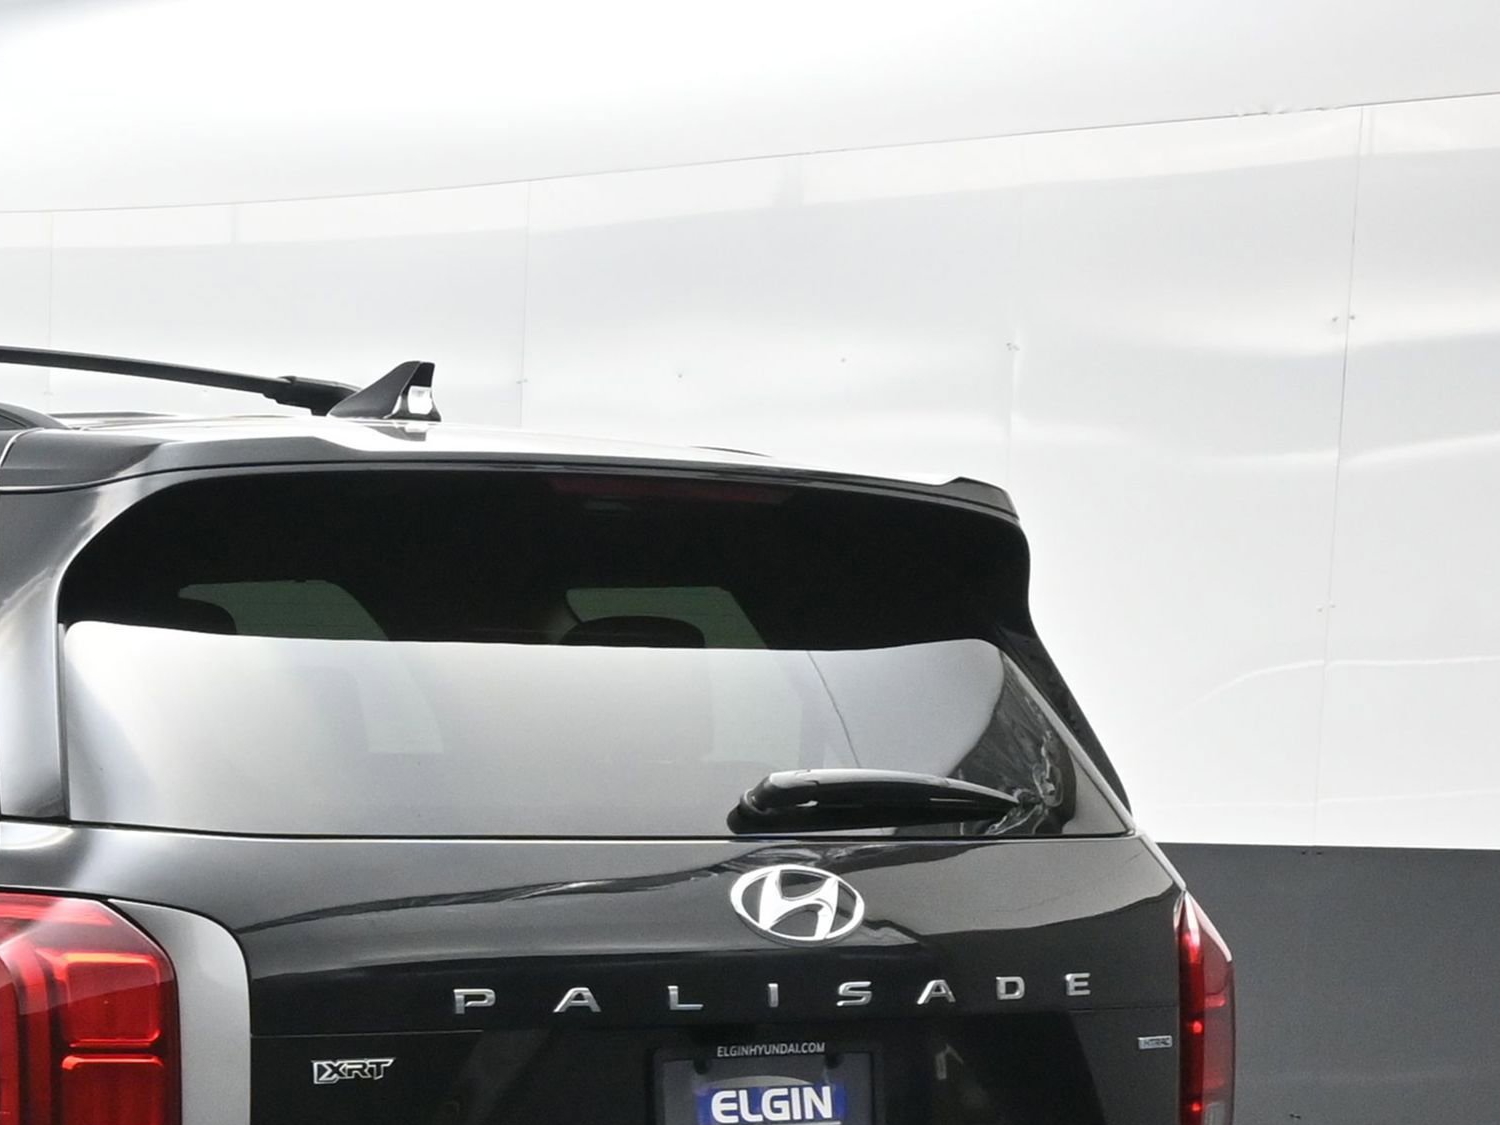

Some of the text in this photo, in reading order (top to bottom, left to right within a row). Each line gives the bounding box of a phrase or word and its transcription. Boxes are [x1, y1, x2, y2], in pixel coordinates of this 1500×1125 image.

[453, 972, 1092, 1014] PALISADE
[717, 1042, 826, 1057] ELGINHYUNDAI.COM
[312, 1058, 396, 1084] XRT
[711, 1086, 833, 1124] ELGIN
